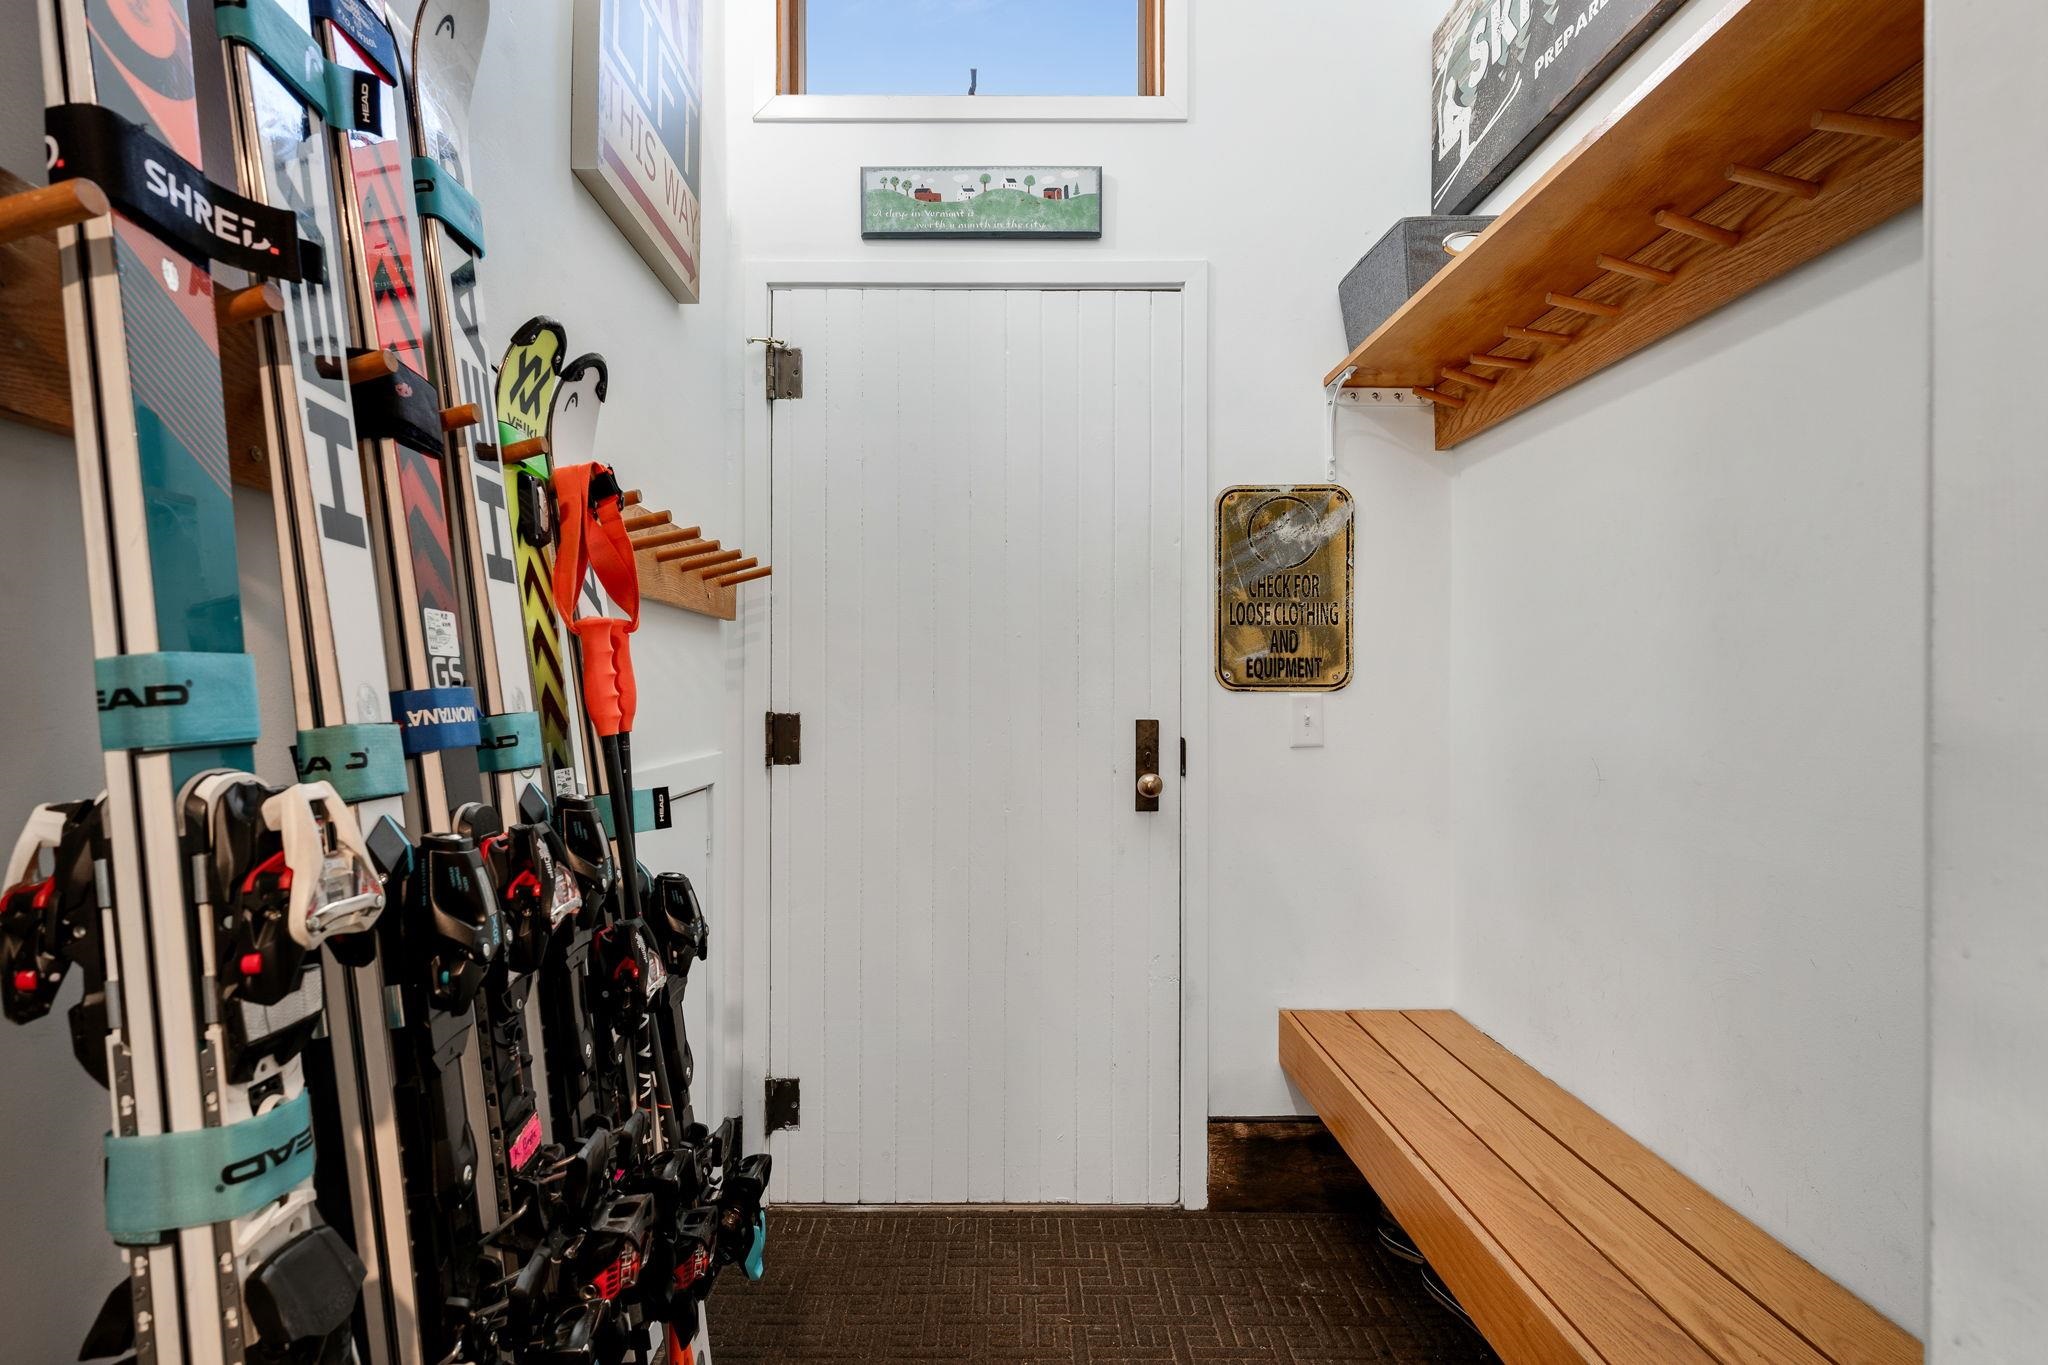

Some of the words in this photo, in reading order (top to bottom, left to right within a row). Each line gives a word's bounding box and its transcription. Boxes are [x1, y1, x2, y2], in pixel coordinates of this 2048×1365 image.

[360, 83, 371, 123] HEAD
[604, 66, 656, 182] THIS
[664, 157, 698, 243] WAY
[1250, 574, 1293, 598] CHECK
[1294, 575, 1320, 598] FOR
[1229, 602, 1271, 625] LOOSE
[1274, 602, 1339, 626] CLOTHING
[1270, 630, 1299, 653] AND
[432, 656, 464, 688] GS
[1246, 657, 1322, 679] EQUIPMENT
[406, 706, 475, 727] MONTANA
[658, 794, 666, 822] HEAD
